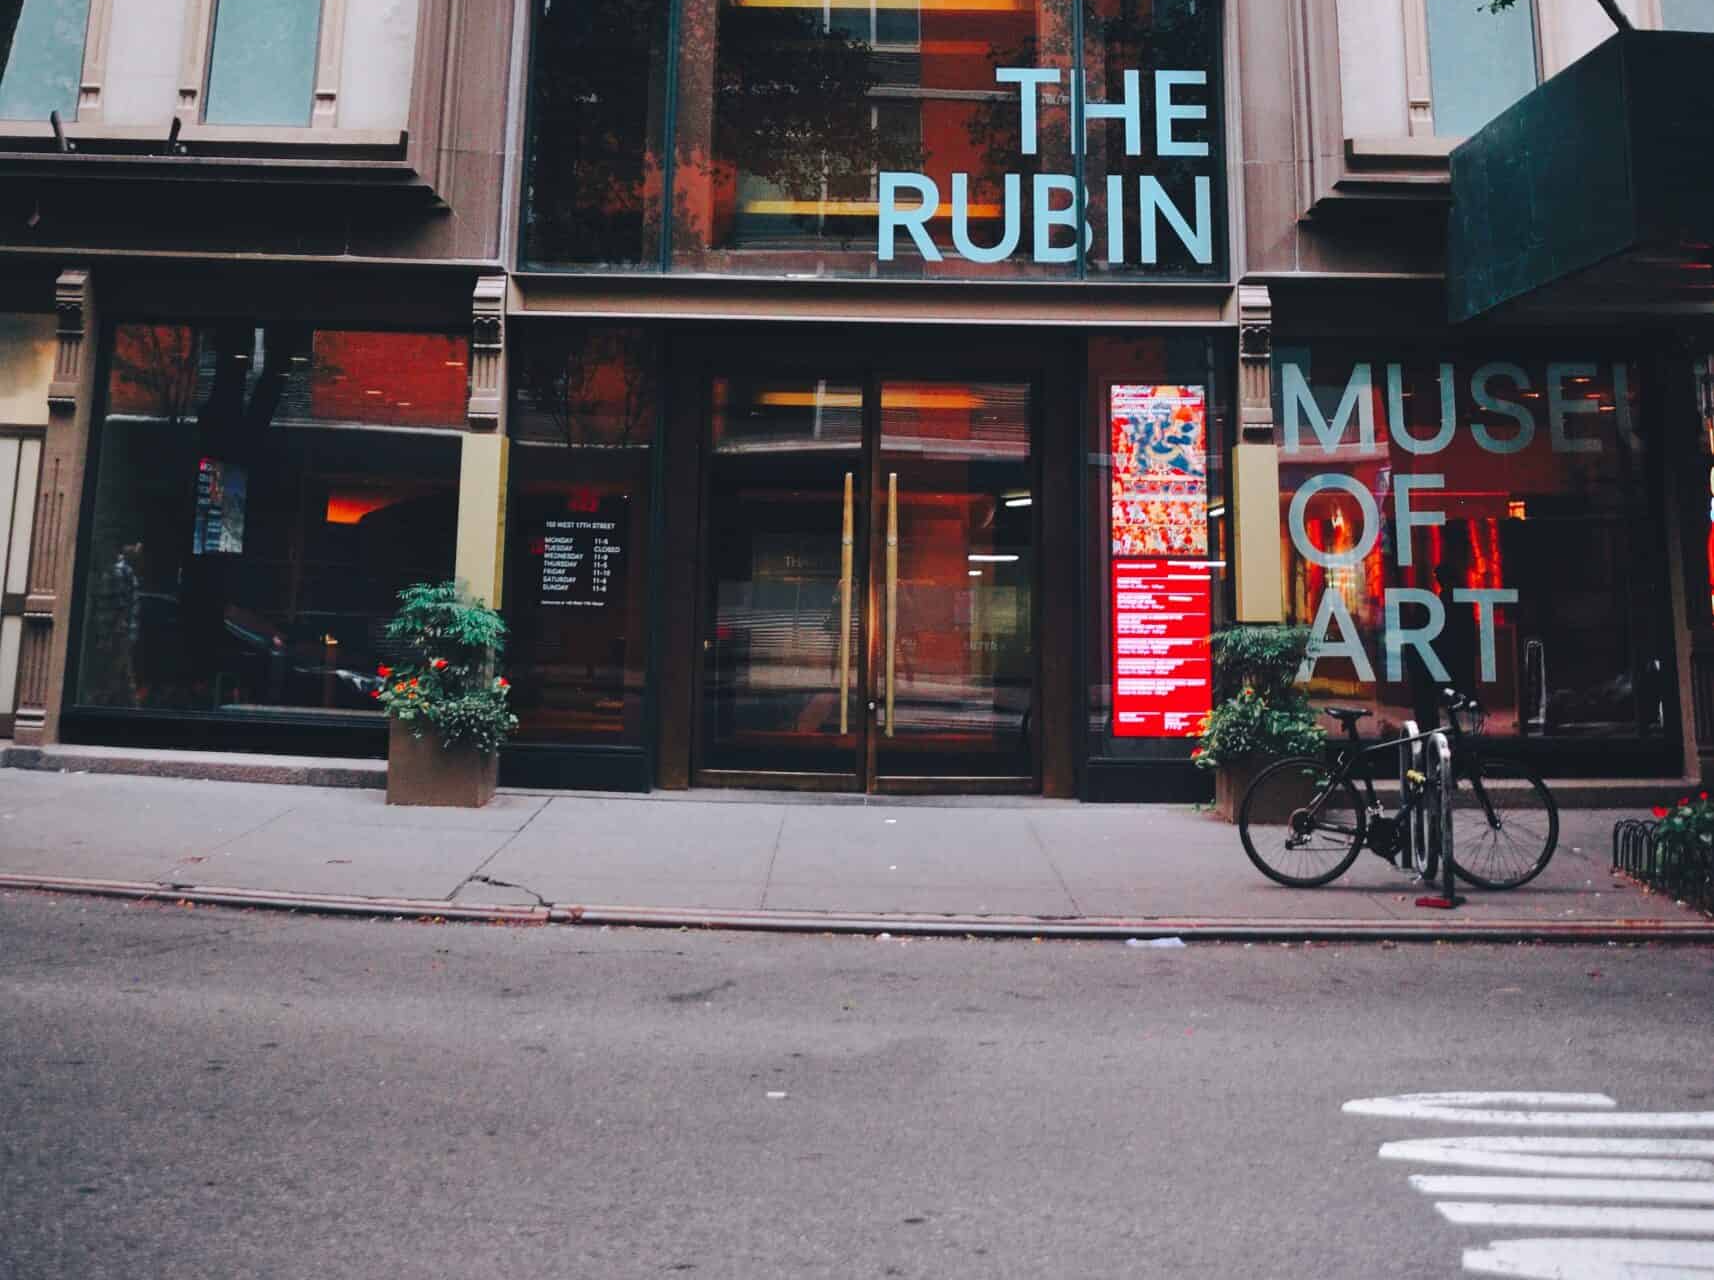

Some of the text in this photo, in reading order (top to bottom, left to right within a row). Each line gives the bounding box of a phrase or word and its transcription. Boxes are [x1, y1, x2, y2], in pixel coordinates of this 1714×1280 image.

[996, 68, 1209, 156] THE
[877, 171, 1213, 265] RUBIN
[1288, 473, 1447, 569] OF
[1297, 586, 1519, 683] ART
